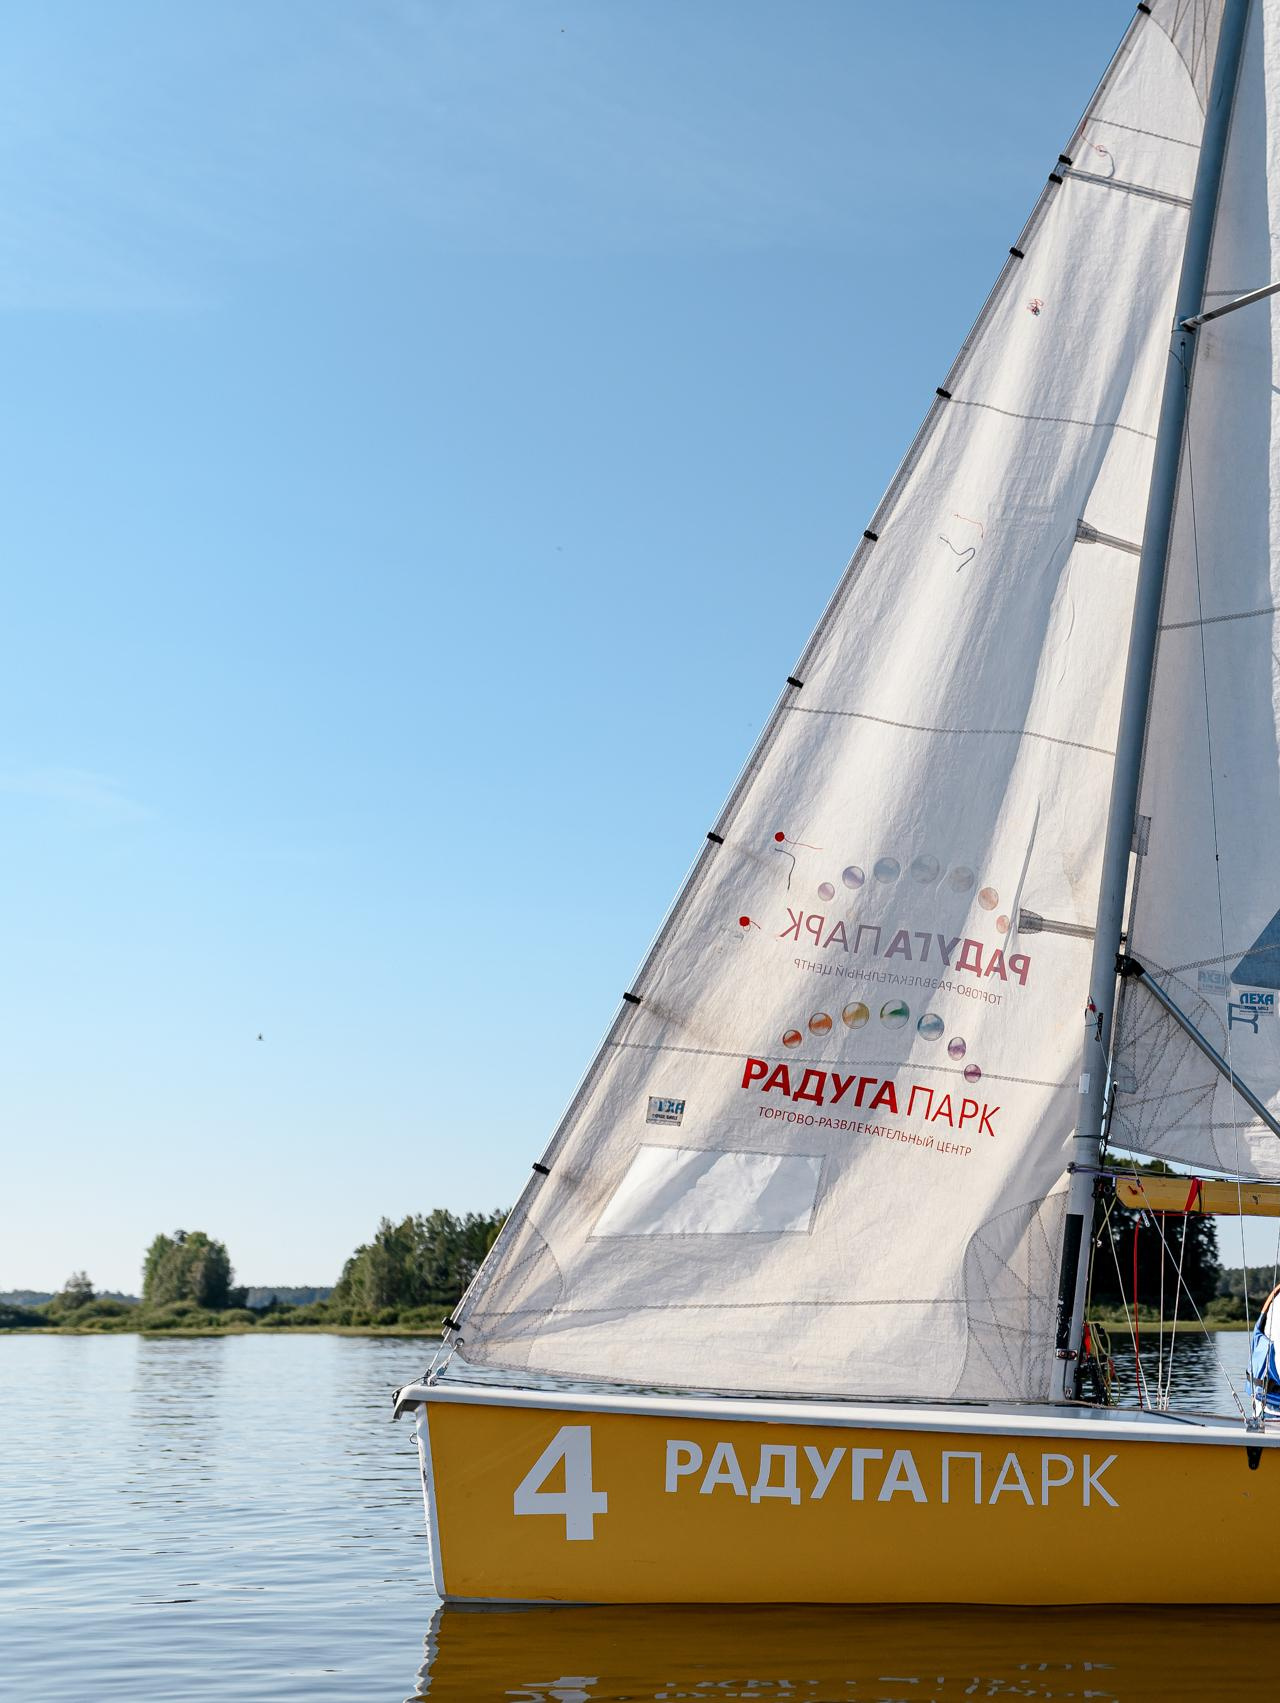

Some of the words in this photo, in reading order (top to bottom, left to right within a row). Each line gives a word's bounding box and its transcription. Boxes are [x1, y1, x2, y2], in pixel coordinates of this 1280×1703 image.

[1240, 992, 1274, 1005] ЛЕХА
[759, 1106, 935, 1149] ТОРГОВО-РАЗВЛЕКАТЕЛЬНЫЙ
[936, 1140, 972, 1157] ЦЕНТР
[513, 1425, 608, 1540] 4
